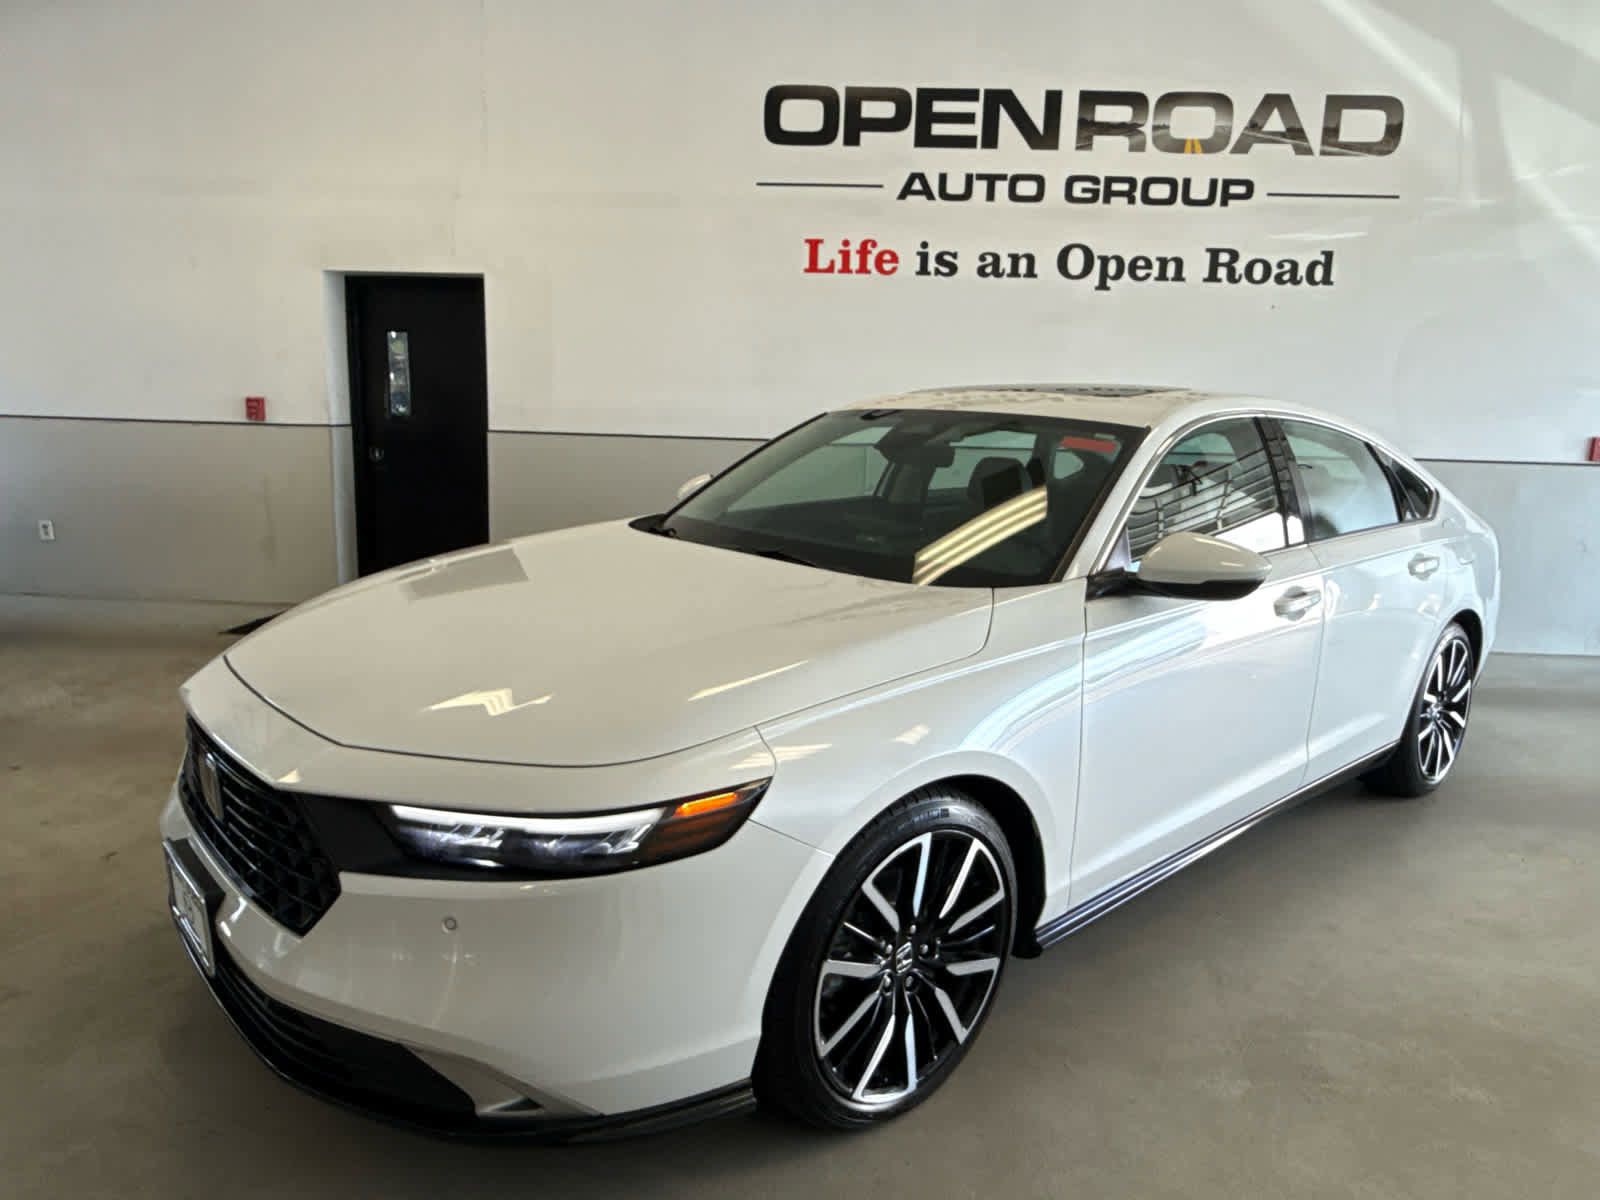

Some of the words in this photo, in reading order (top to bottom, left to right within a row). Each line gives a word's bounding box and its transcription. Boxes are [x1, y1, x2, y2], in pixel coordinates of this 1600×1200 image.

[764, 85, 1063, 150] OPEN
[1075, 90, 1404, 156] ROAD
[897, 172, 1046, 203] AUTO
[1064, 175, 1255, 207] GROUP
[803, 238, 899, 276] Life
[915, 241, 958, 277] is
[977, 252, 1038, 278] an
[1057, 243, 1186, 291] Open
[1203, 248, 1334, 286] Road
